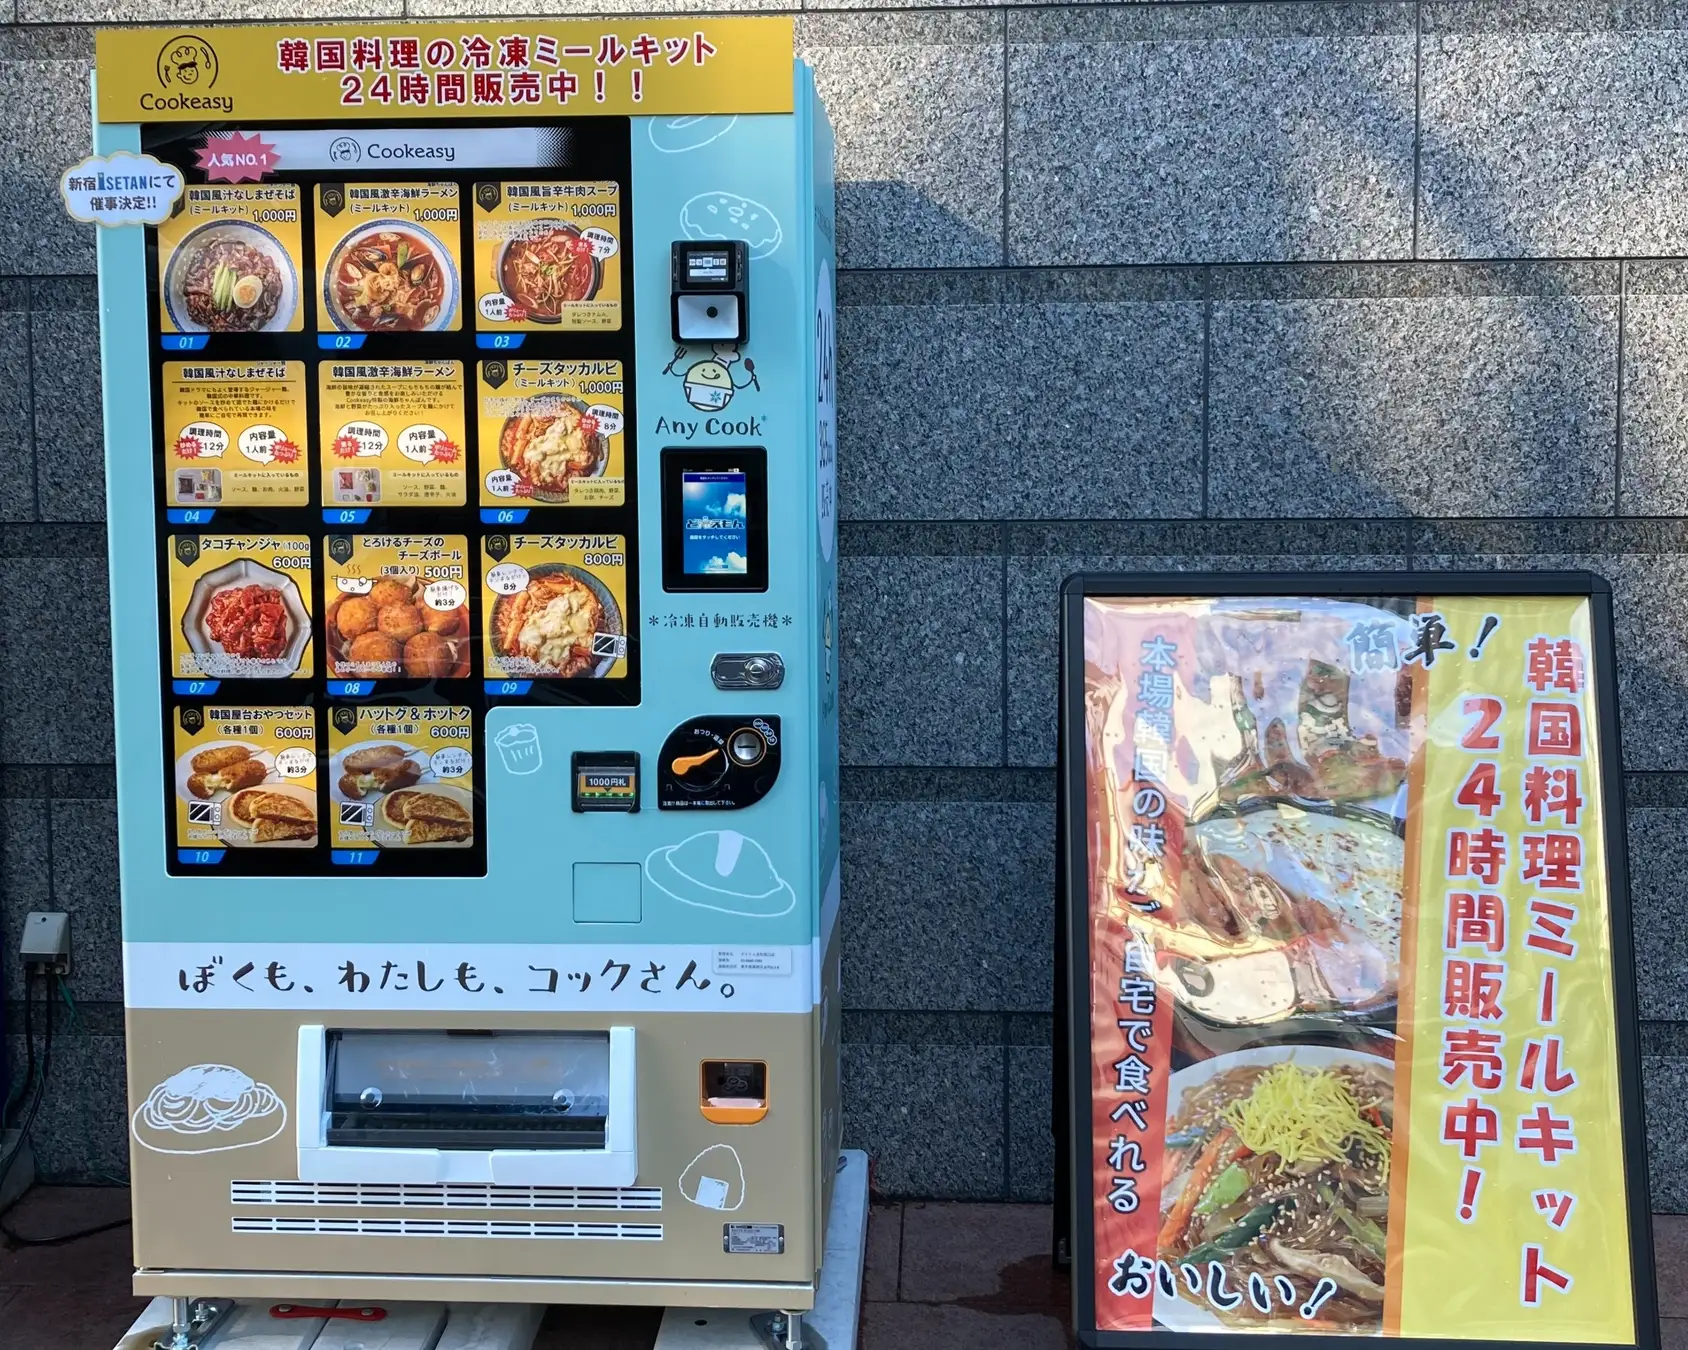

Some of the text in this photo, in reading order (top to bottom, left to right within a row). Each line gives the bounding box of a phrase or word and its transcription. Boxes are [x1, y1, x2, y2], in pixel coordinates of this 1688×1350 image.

[278, 33, 716, 71] 韓国料理の冷凍ミールキット
[340, 71, 644, 105] 24時間販売中!!
[140, 93, 234, 113] Cookeasy
[367, 143, 455, 161] Cookeasy
[208, 152, 268, 168] 人気NO.1
[189, 189, 296, 201] 韓国風汁なしまぜそば
[350, 188, 458, 199] 韓国風激辛海鮮ラーメン
[507, 185, 618, 197] 韓国風旨辛牛肉スープ
[90, 196, 156, 211] 催事決定!!
[350, 204, 410, 214] (ミールキット)
[508, 202, 568, 213] (ミールキット)
[190, 205, 249, 215] (ミールキット)
[253, 209, 296, 222] 1,000円
[414, 209, 458, 221] 1,000円
[571, 204, 616, 217] 1,000円
[598, 246, 611, 254] 7分
[179, 337, 194, 348] 01
[335, 336, 351, 348] 02
[494, 335, 510, 347] 03
[182, 367, 286, 379] 韓国風汁なしまぜそば
[332, 366, 455, 378] 韓国風激辛海鮮ラーメン
[512, 361, 617, 376] チーズタッカルビ
[514, 378, 576, 388] (ミールキット)
[579, 381, 624, 394] 1,000円
[189, 427, 222, 438] 調理時間
[347, 427, 381, 438] 調理時間
[655, 416, 762, 440] Any Cook
[249, 430, 276, 441] 内容量
[409, 429, 436, 441] 内容量
[203, 441, 224, 450] 12分
[245, 445, 267, 454] 1人前
[362, 441, 383, 450] 12分
[405, 445, 427, 454] 1人前
[184, 510, 200, 522] 04
[340, 510, 356, 522] 05
[498, 511, 514, 523] 06
[362, 537, 444, 548] とろけるチーズの
[514, 536, 618, 549] チーズタッカルビ
[398, 550, 462, 561] チーズボール
[584, 553, 624, 566] 800円
[272, 556, 311, 569] 600円
[380, 566, 420, 575] (3個入り)
[424, 565, 463, 579] 500円
[435, 598, 455, 607] 約3分
[1346, 614, 1499, 672] 簡単!
[189, 682, 205, 694] 07
[345, 682, 360, 694] 08
[501, 682, 517, 694] 09
[209, 709, 312, 720] 韓国屋台おやつセット
[217, 725, 264, 735] (各種1個)
[275, 727, 313, 739] 600円
[370, 724, 420, 734] (各種1個)
[430, 725, 470, 738] 600円
[442, 766, 463, 774] 約3分
[589, 778, 627, 786] 1000円札
[195, 851, 209, 862] 10
[349, 852, 363, 863] 11
[1440, 697, 1506, 1222] 24時間販売中!
[1517, 635, 1585, 1306] 韓国料理ミールキット
[1109, 1249, 1337, 1319] おいしい!
